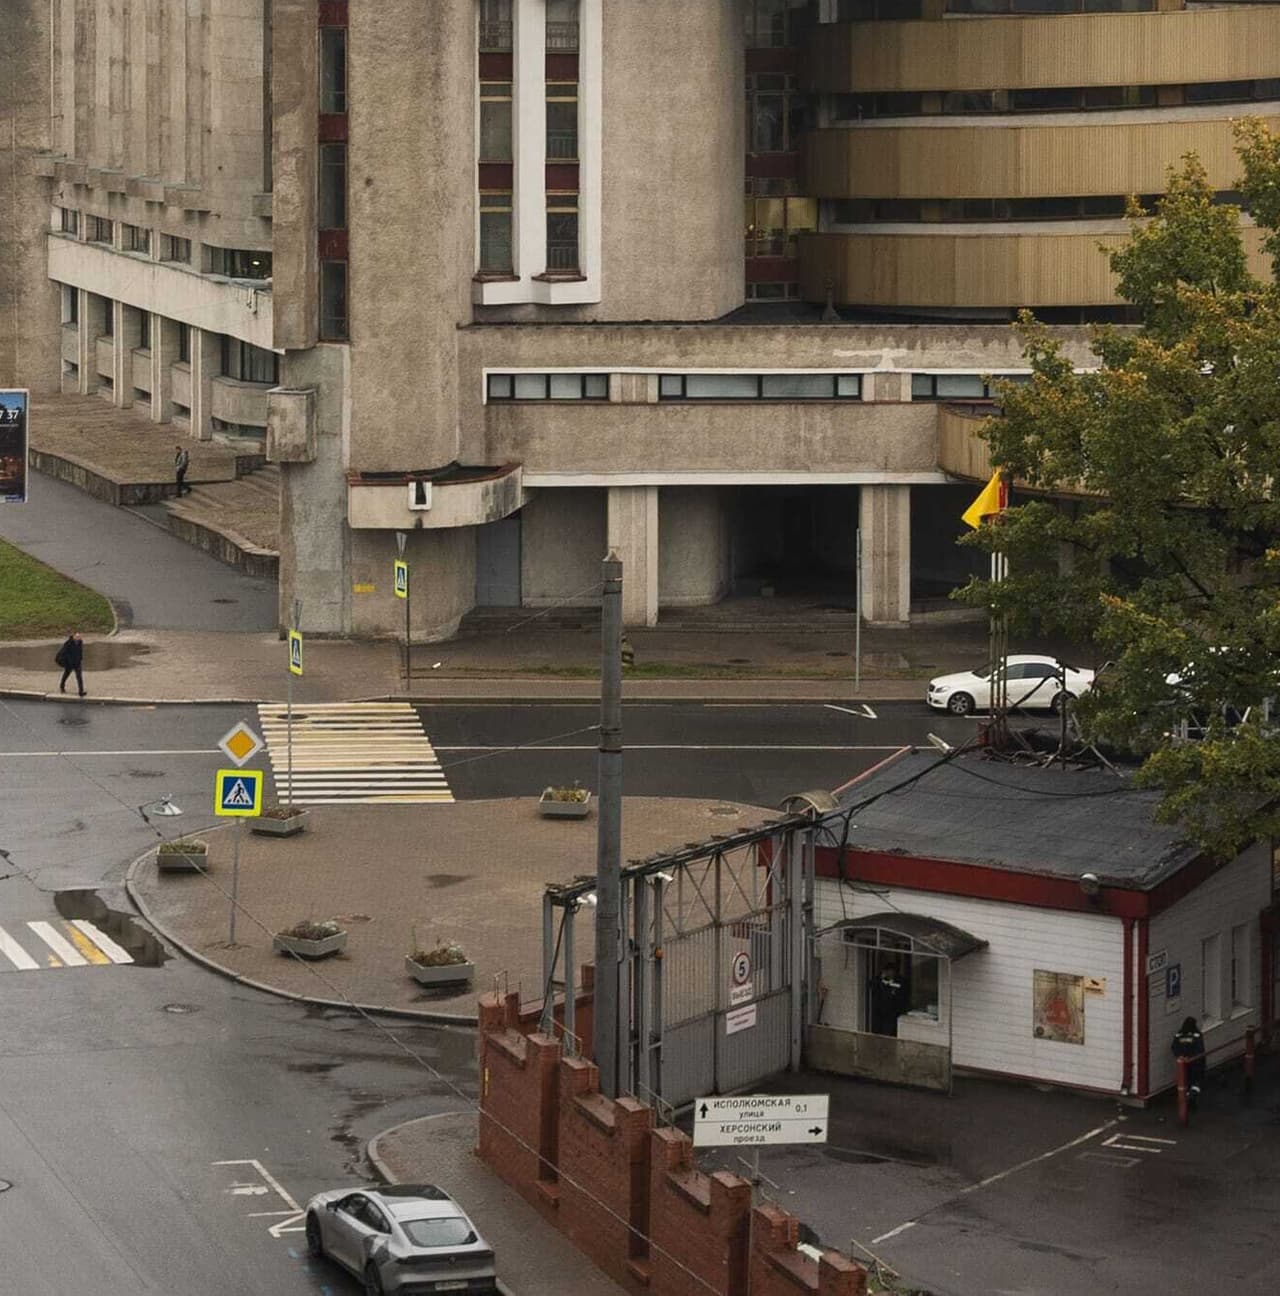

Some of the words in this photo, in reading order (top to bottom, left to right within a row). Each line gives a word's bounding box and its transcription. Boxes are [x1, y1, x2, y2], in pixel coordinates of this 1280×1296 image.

[6, 409, 19, 420] 37
[738, 960, 746, 978] 5
[713, 1098, 791, 1109] ИСПОЛКОМСКАЯ
[795, 1104, 807, 1114] 0,1
[739, 1111, 764, 1119] улица
[720, 1121, 782, 1134] ХЕРСОНСКИЙ
[733, 1135, 765, 1144] проезд
